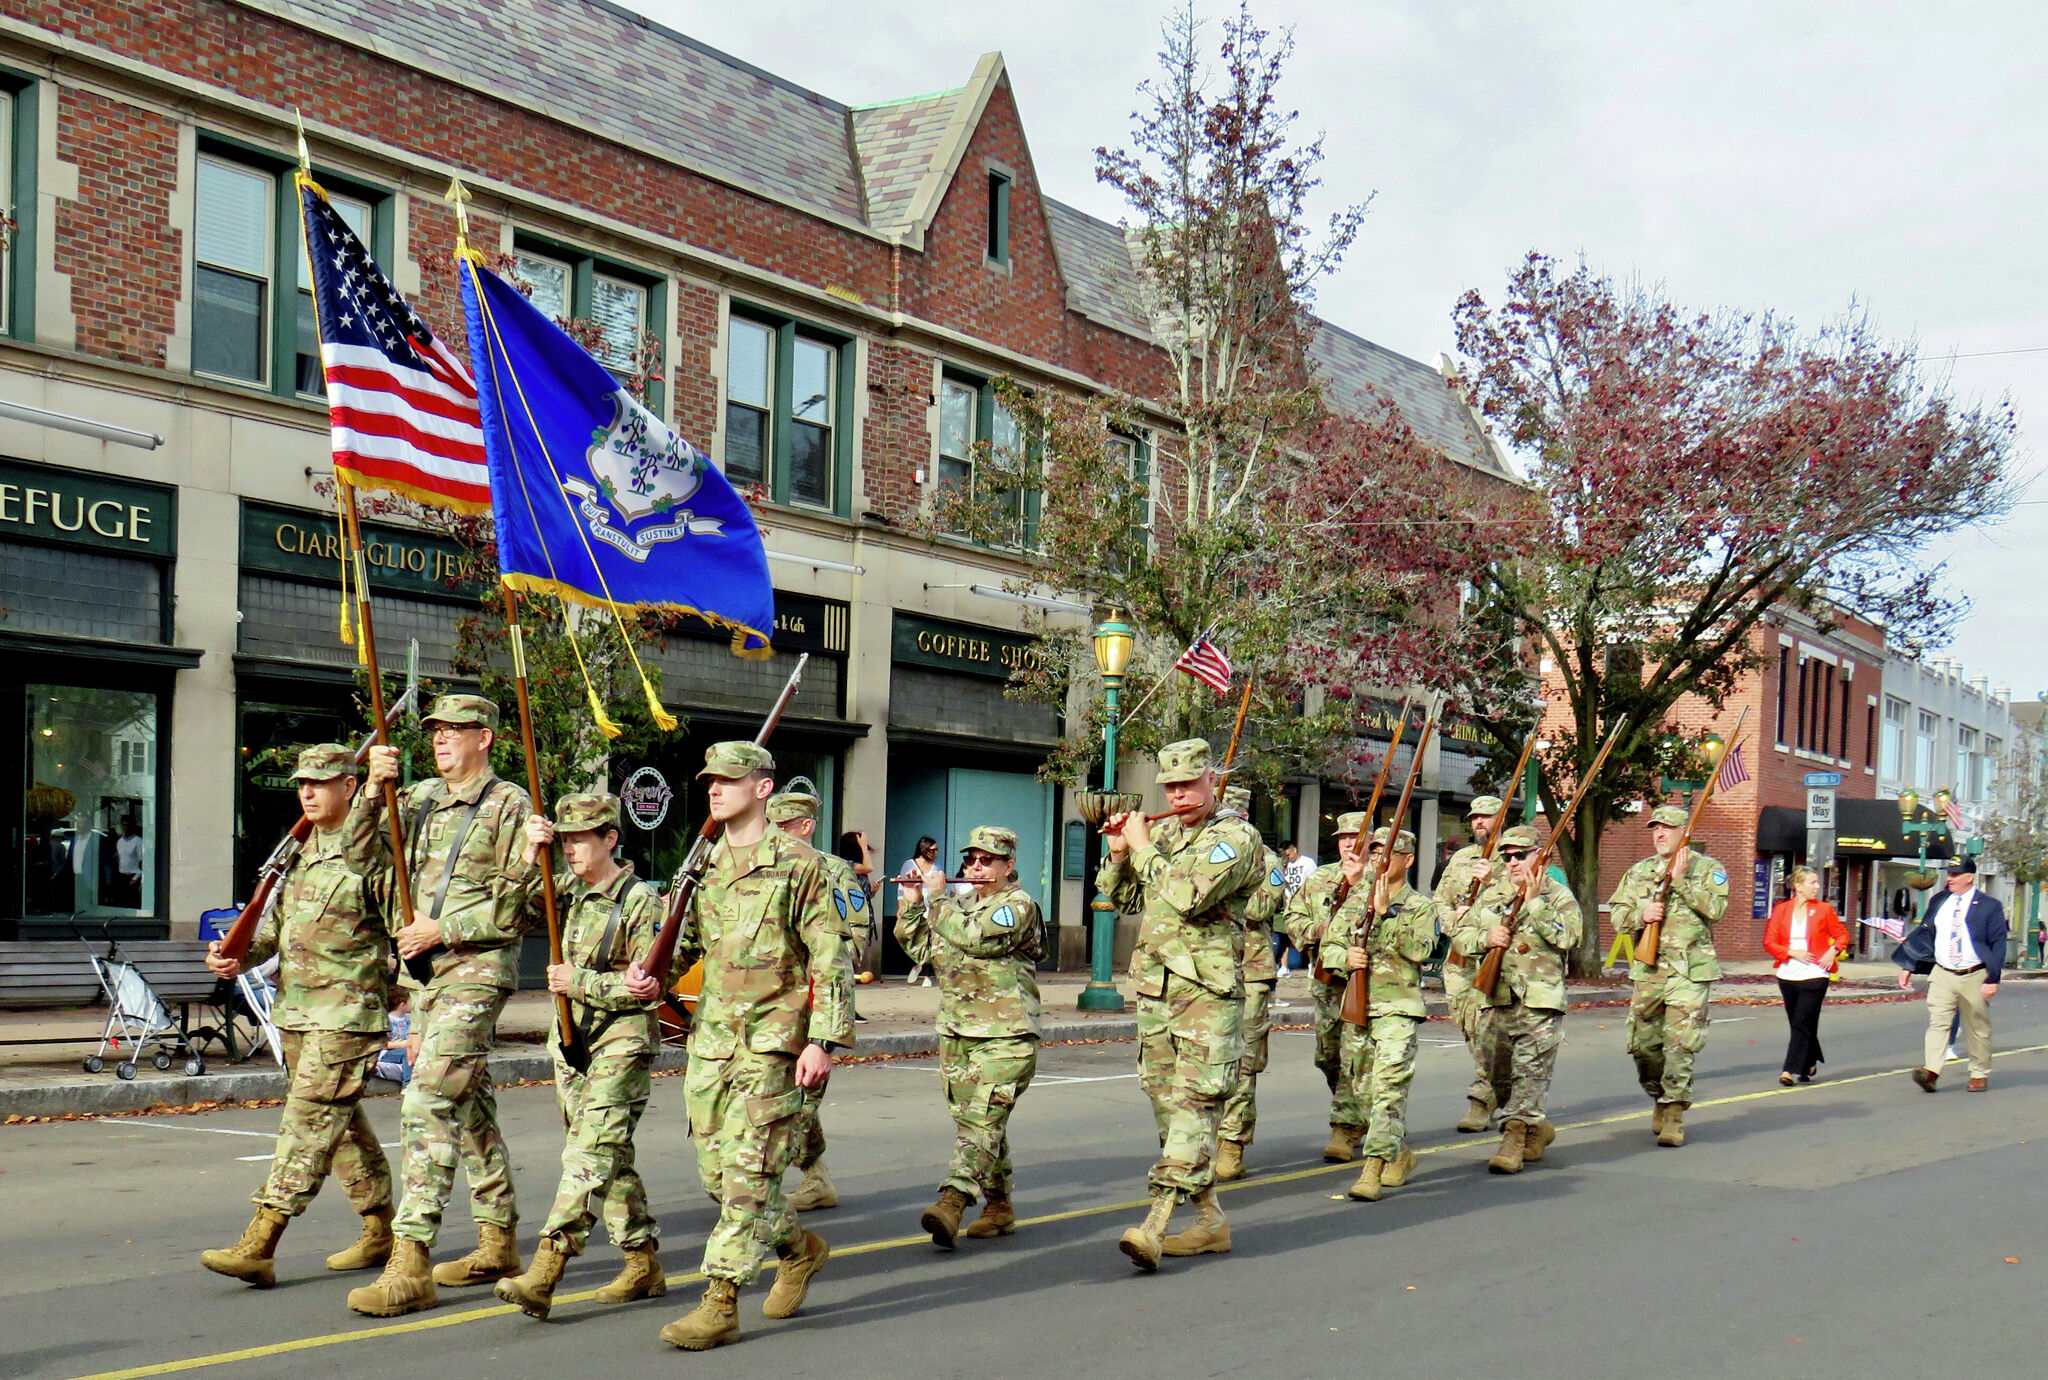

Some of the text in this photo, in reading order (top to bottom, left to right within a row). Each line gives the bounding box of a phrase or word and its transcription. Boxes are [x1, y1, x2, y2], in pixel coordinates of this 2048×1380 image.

[0, 483, 152, 543] EFUGE
[582, 503, 599, 517] QUI
[591, 521, 641, 557] TRANSTULIT
[640, 524, 684, 544] SUSTINET
[276, 523, 426, 572] CIARLGLIO
[918, 630, 1047, 670] COFFEE SHOP
[1812, 794, 1830, 804] One
[1811, 806, 1830, 818] Way
[1289, 875, 1301, 885] DO
